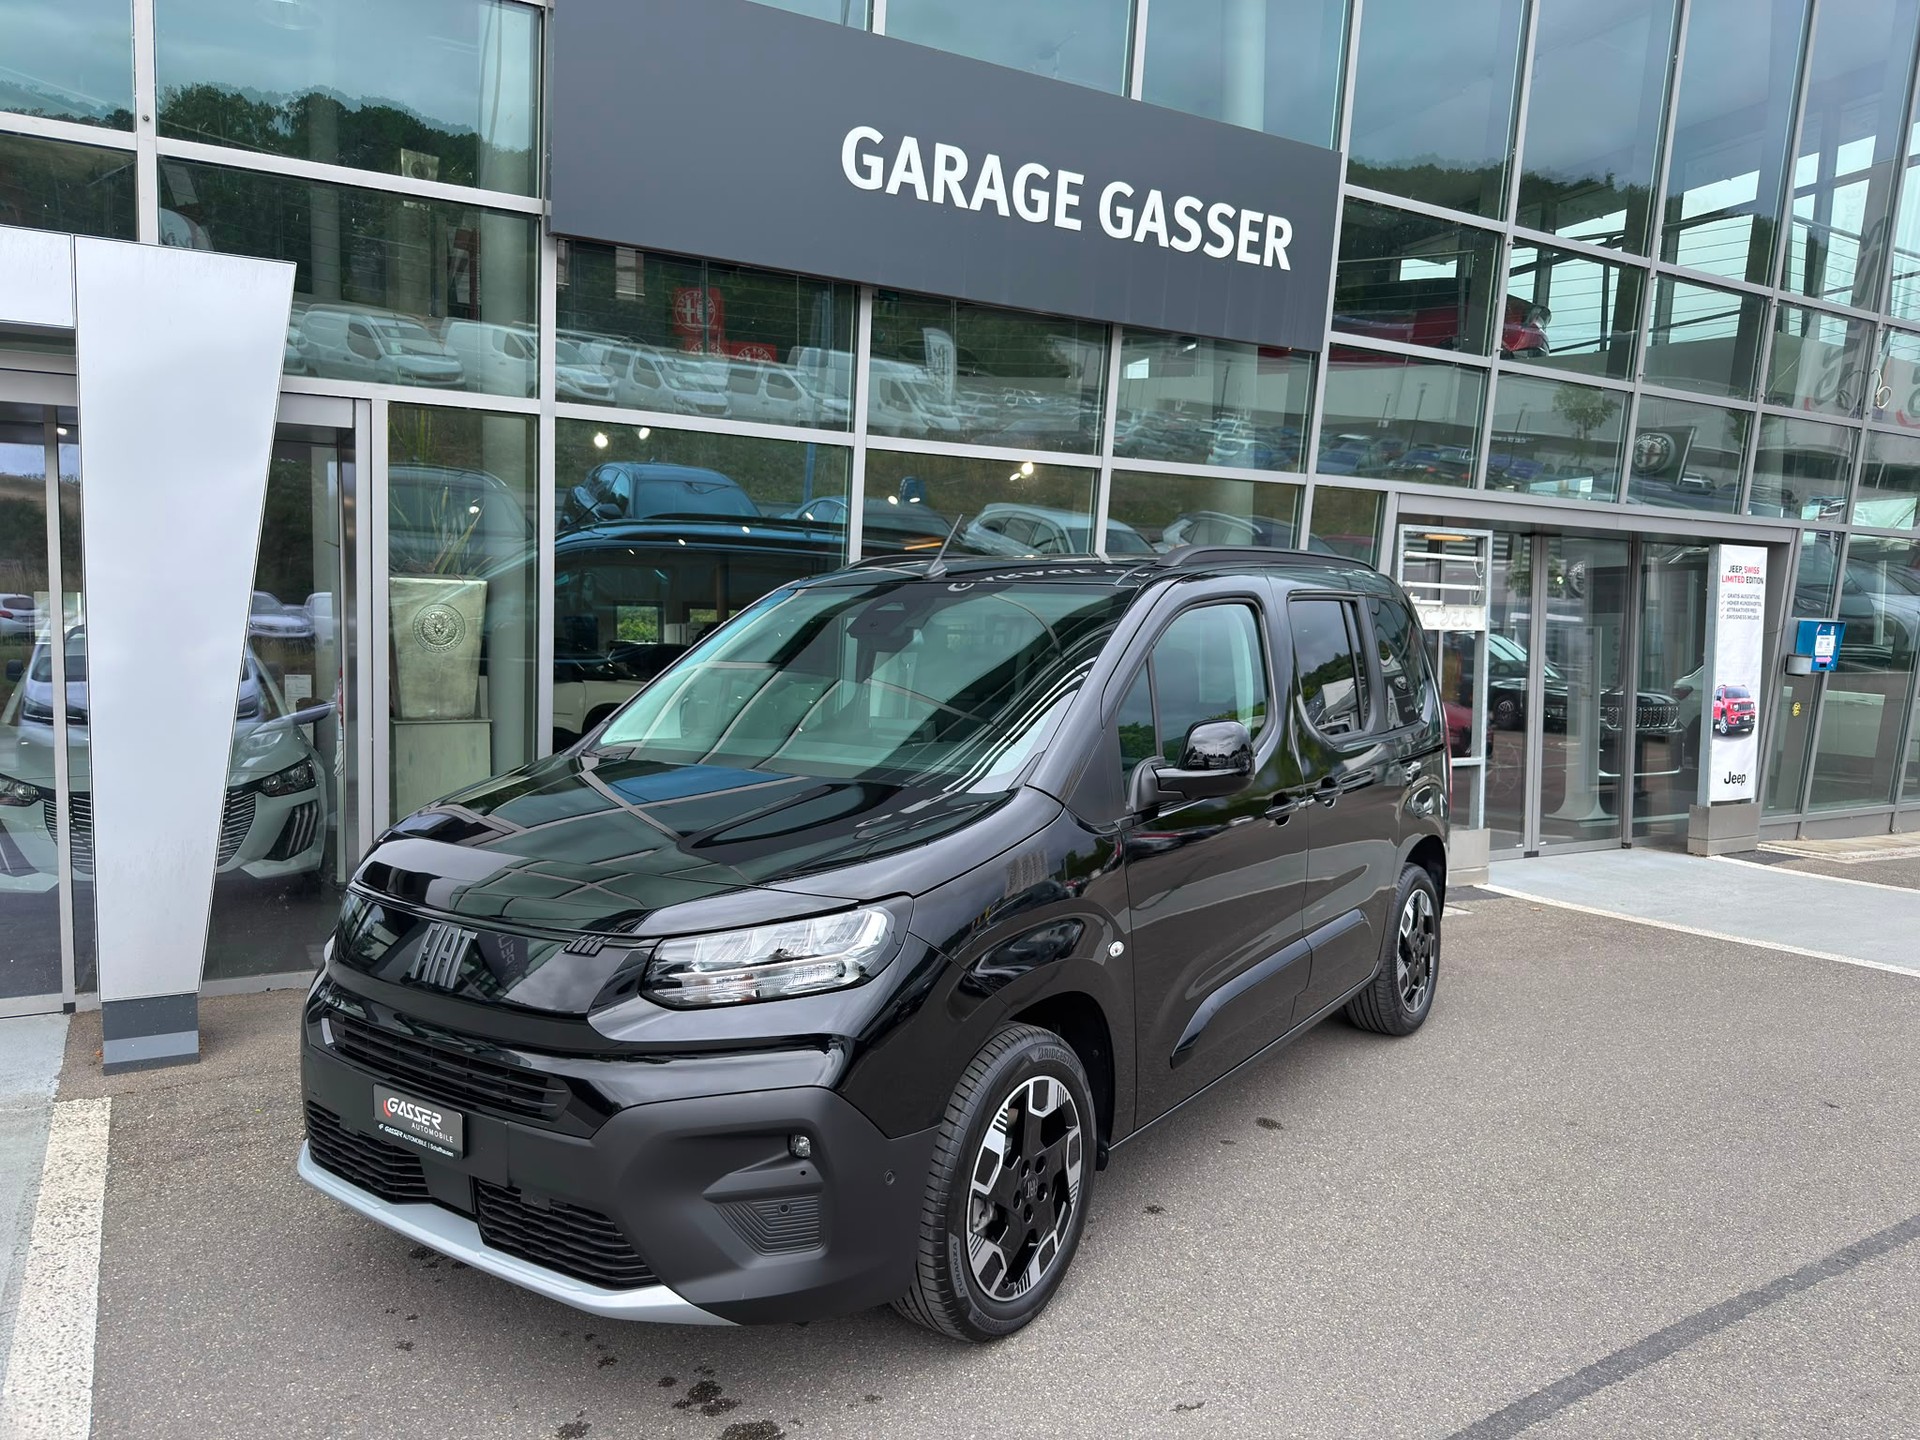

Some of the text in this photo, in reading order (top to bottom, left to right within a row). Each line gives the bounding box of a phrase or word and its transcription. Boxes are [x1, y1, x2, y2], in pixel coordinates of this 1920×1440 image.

[841, 125, 1293, 271] GARAGE GASSER
[1721, 575, 1764, 584] LIMITED EDITION
[1728, 565, 1760, 574] JEEP, SWISS
[1724, 771, 1746, 786] Jeep
[408, 922, 478, 989] FIAT
[387, 1097, 442, 1131] GASSER
[411, 1122, 454, 1144] AUTOMOBILE
[952, 1241, 965, 1295] TURANZA
